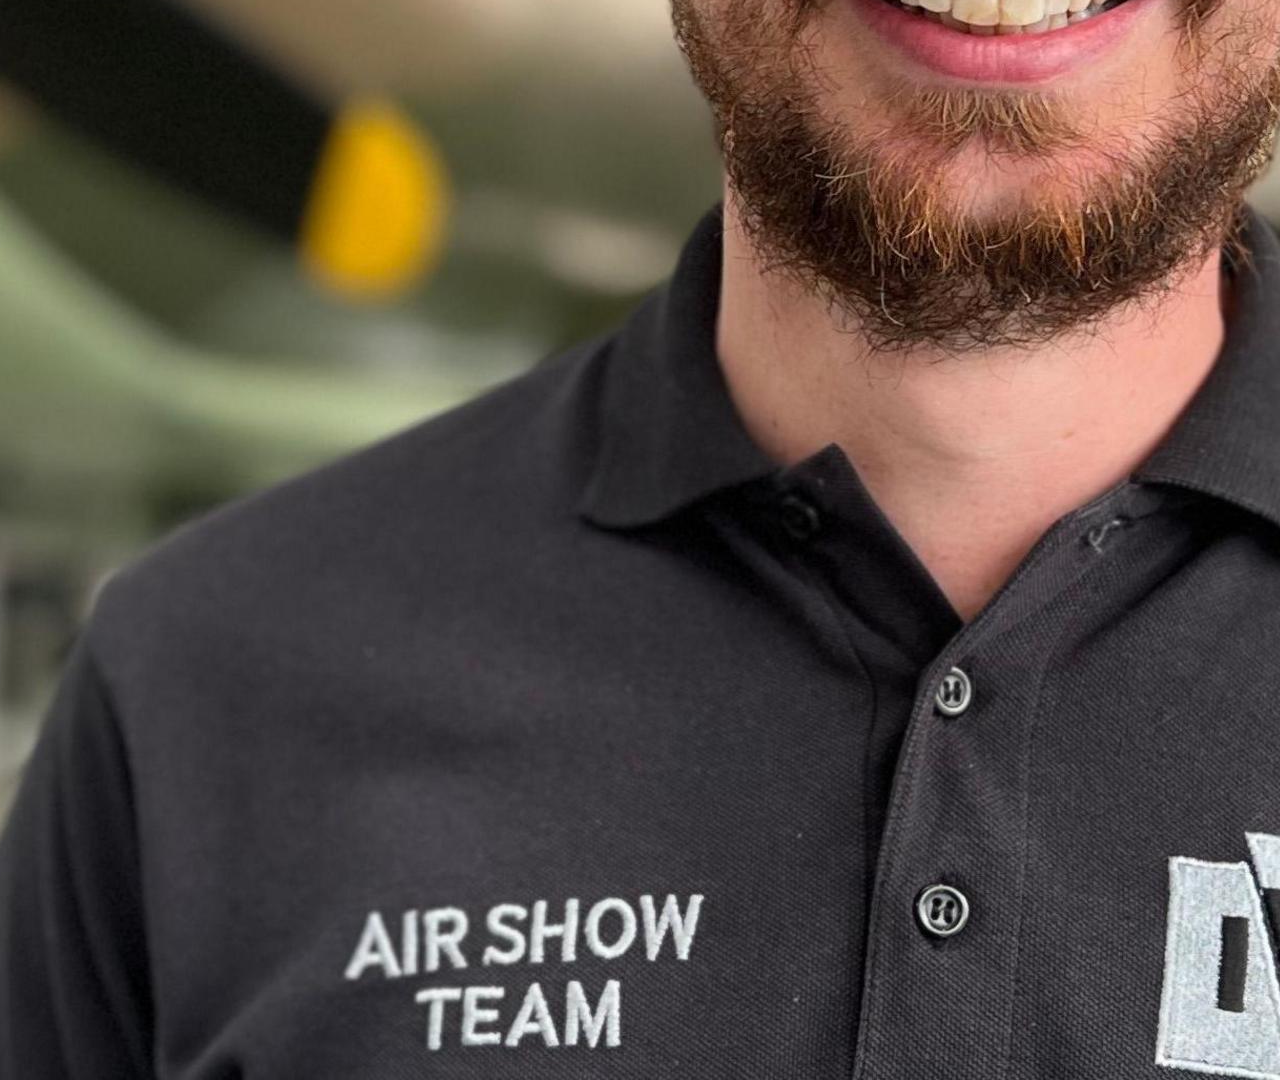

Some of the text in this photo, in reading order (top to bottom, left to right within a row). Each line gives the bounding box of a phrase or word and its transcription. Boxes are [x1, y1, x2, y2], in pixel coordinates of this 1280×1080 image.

[345, 894, 704, 979] AIR SHOW
[416, 979, 621, 1050] TEAM
